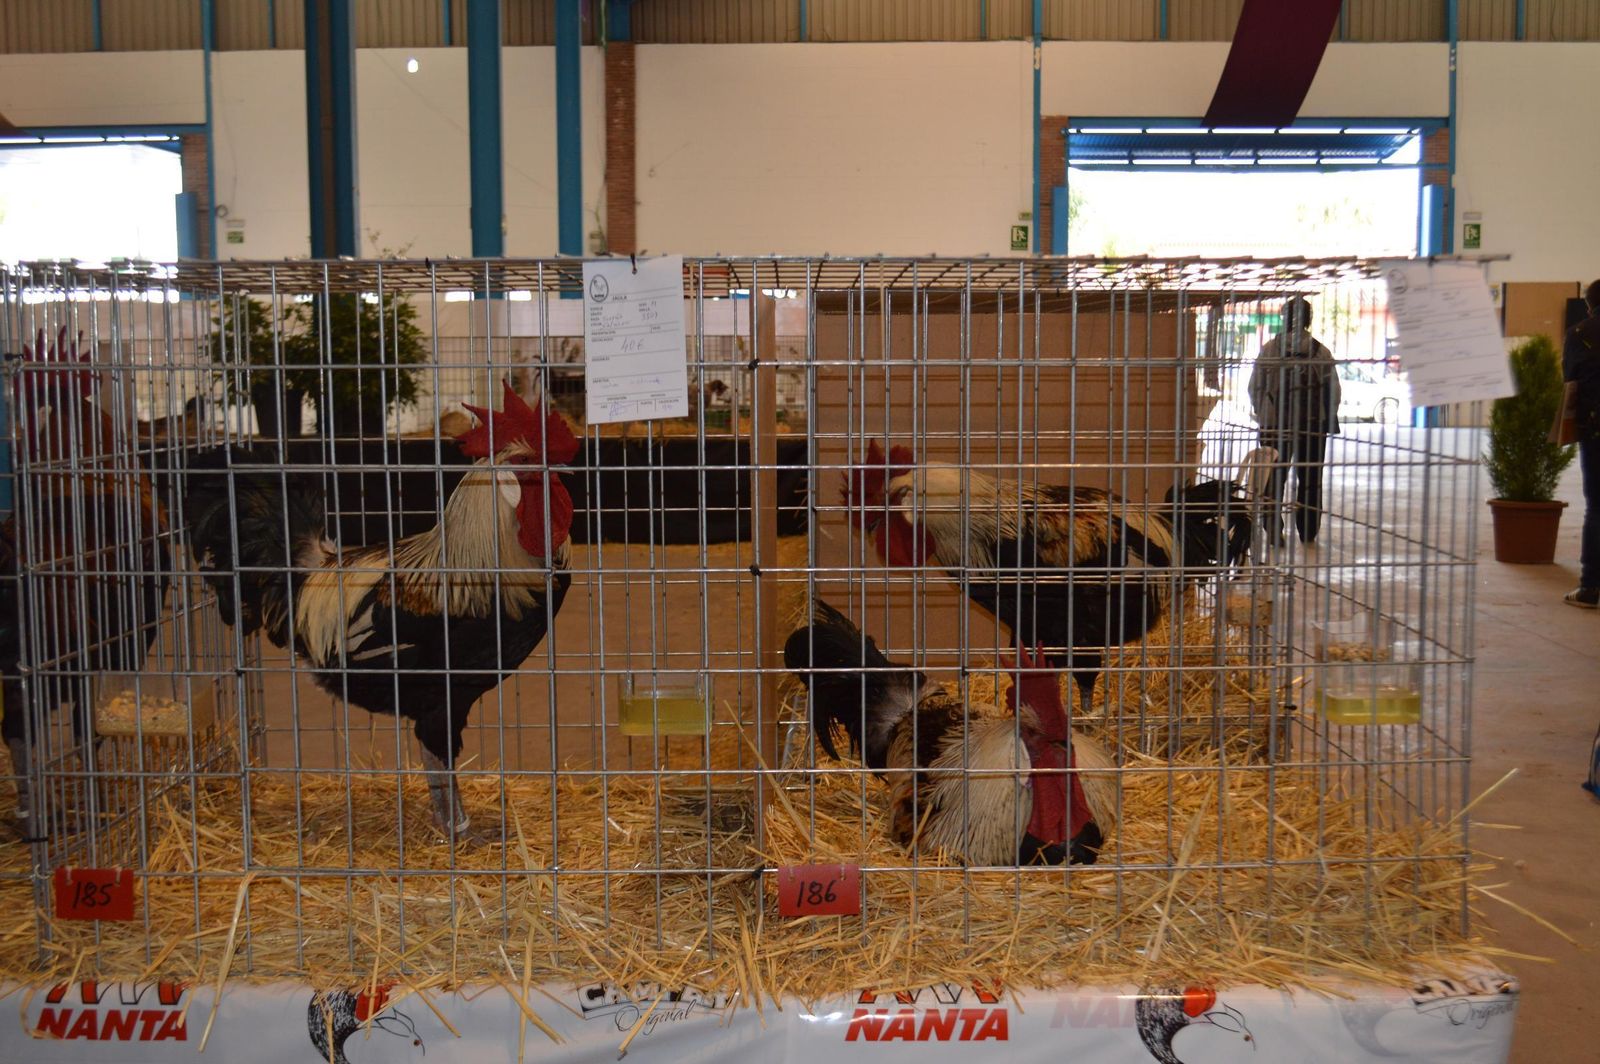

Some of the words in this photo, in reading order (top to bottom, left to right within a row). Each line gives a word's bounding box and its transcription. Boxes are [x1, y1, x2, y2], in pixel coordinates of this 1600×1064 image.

[71, 881, 114, 911] 185
[796, 880, 837, 908] 186
[33, 1008, 188, 1041] NANTA
[845, 1008, 1009, 1041] NANTA
